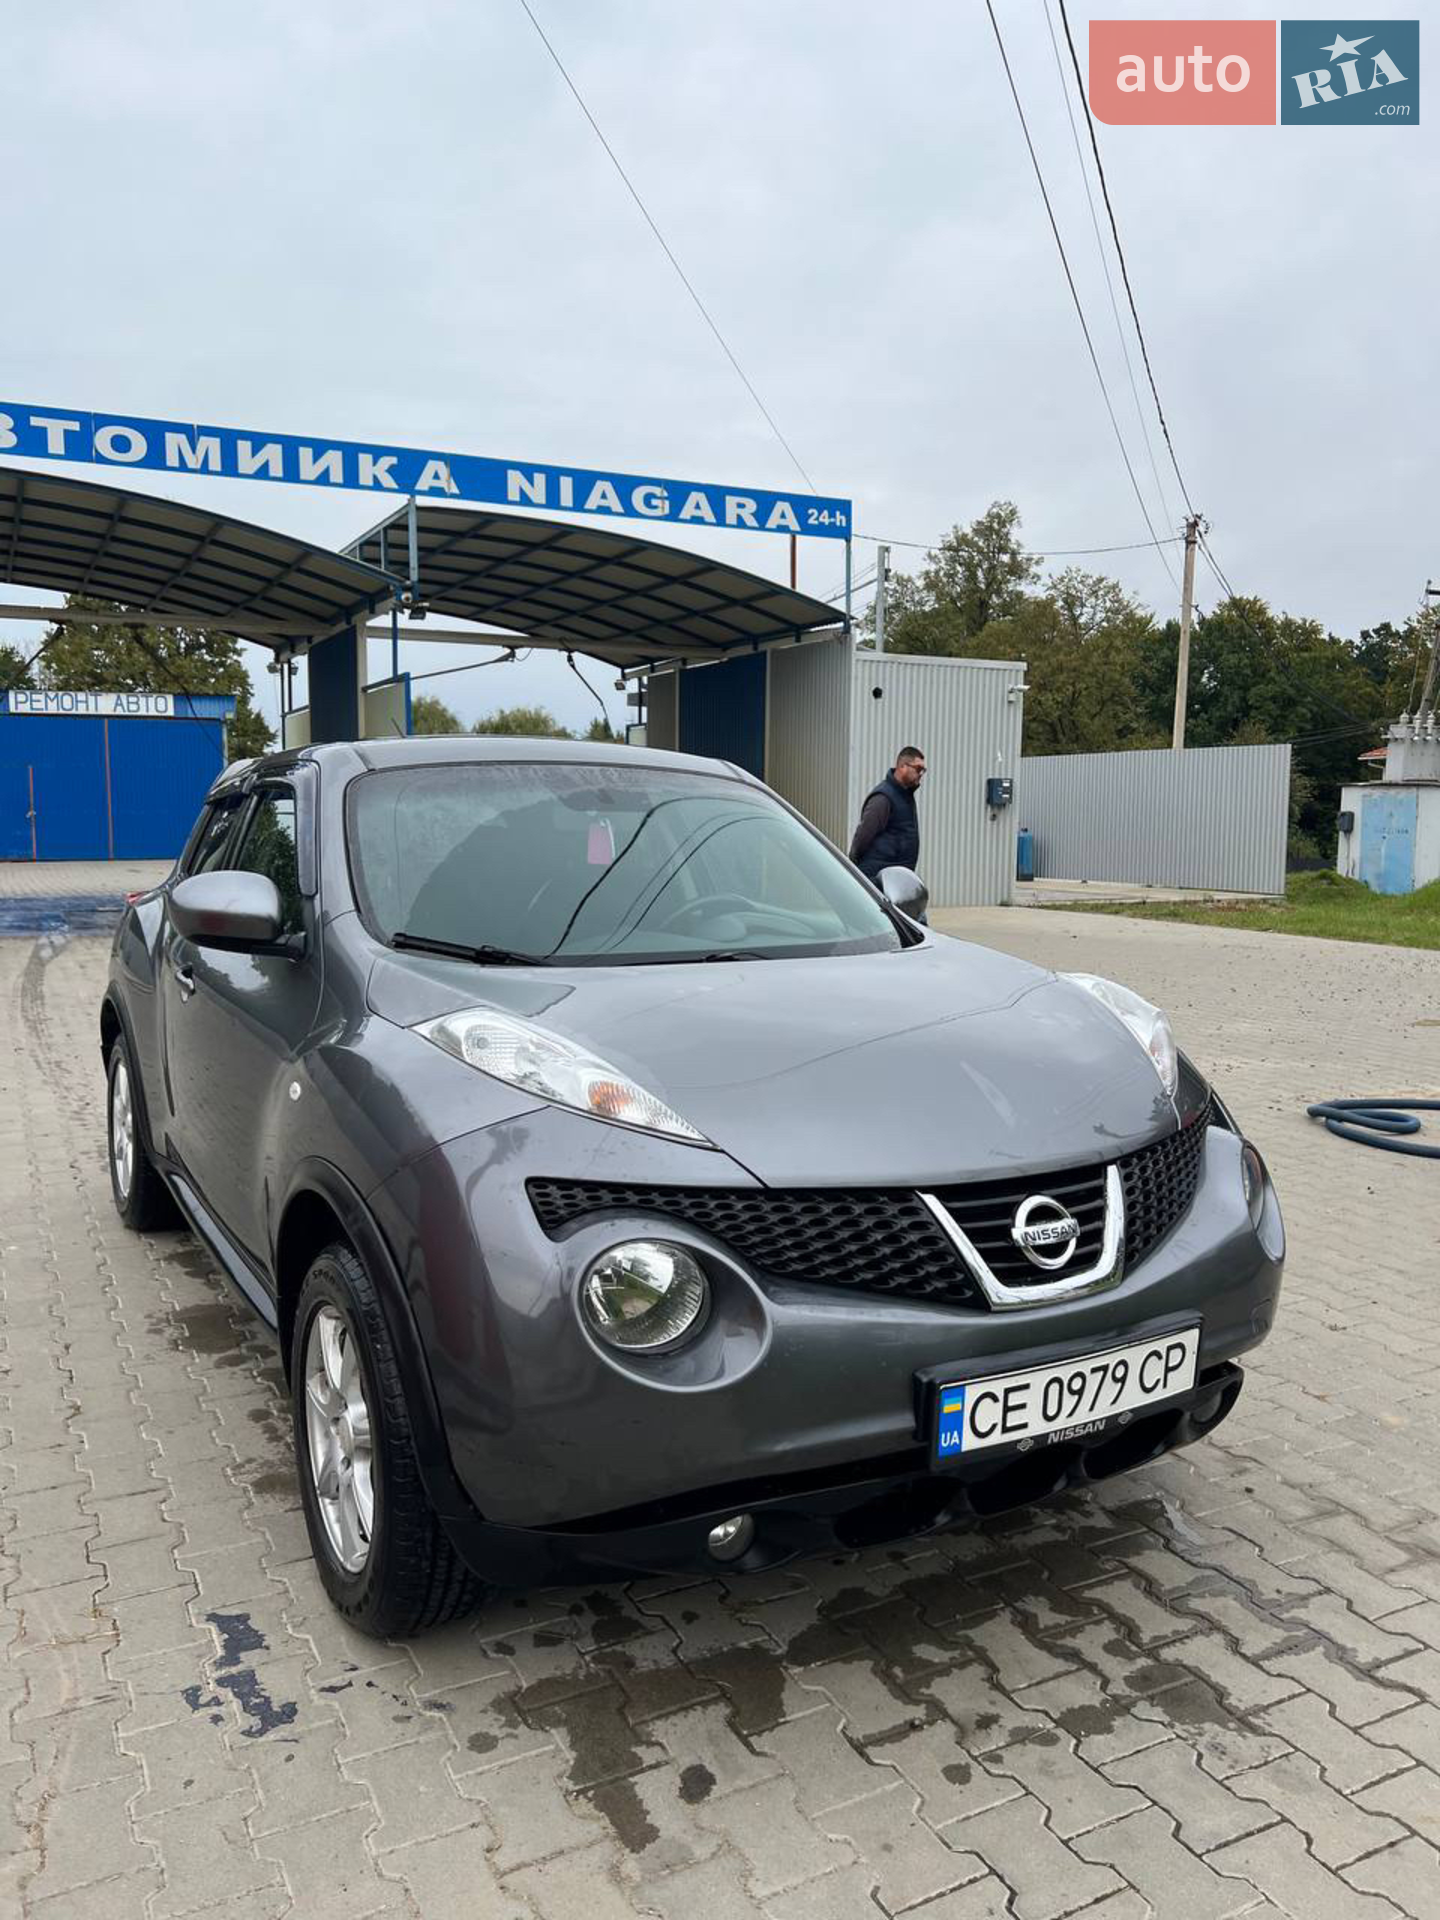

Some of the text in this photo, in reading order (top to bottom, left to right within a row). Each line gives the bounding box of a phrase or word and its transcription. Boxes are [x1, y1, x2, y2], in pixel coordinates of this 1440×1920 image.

[506, 469, 801, 532] NIAGARA
[807, 507, 847, 527] 24-h
[15, 690, 169, 714] РЕМОНТ АВТО
[1023, 1222, 1078, 1242] NISSAN
[969, 1341, 1187, 1439] CE 0979 CP
[941, 1432, 960, 1448] UA
[1047, 1418, 1106, 1445] NISSAN
